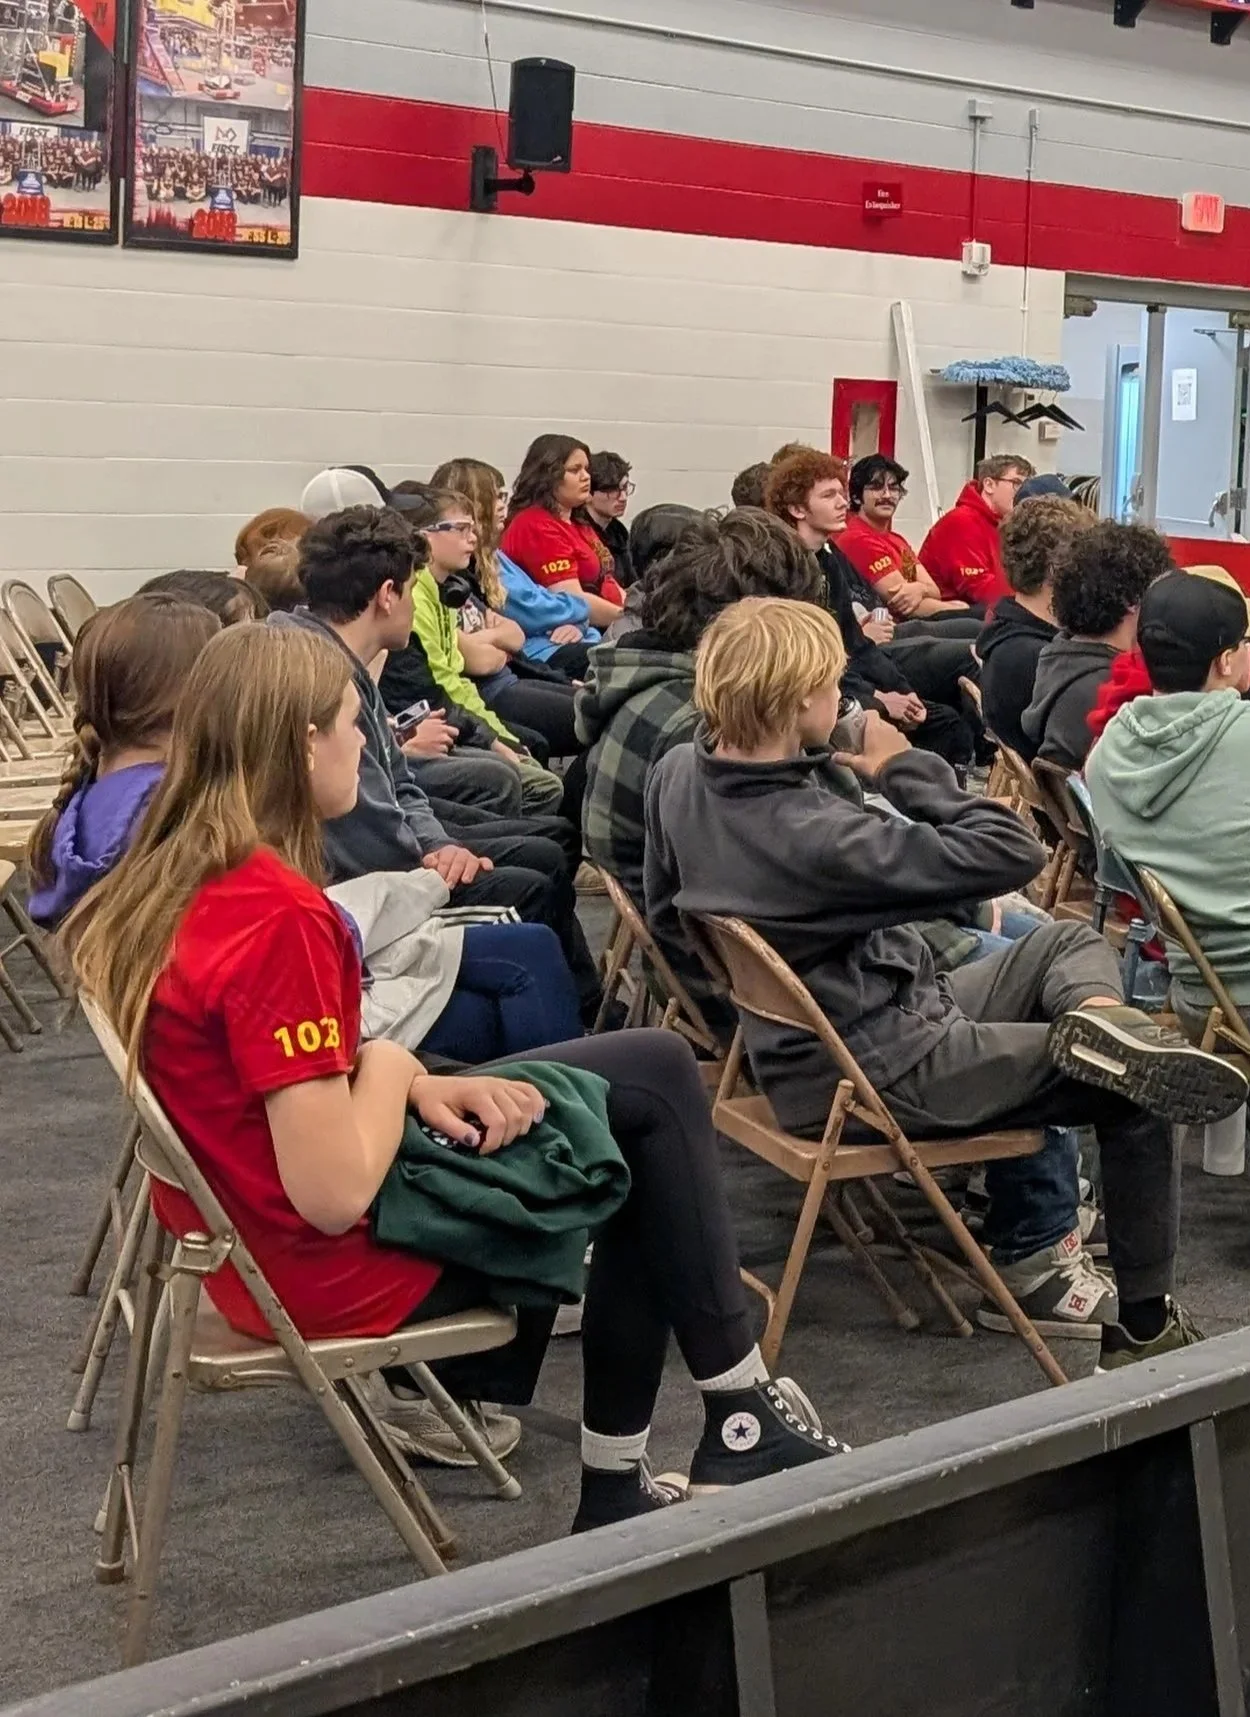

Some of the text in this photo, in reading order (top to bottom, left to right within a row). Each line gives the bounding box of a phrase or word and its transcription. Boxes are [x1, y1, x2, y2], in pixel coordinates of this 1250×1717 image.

[19, 126, 50, 138] FIRST
[211, 143, 240, 155] FIRST
[541, 559, 571, 574] 1023
[868, 555, 892, 574] 1023
